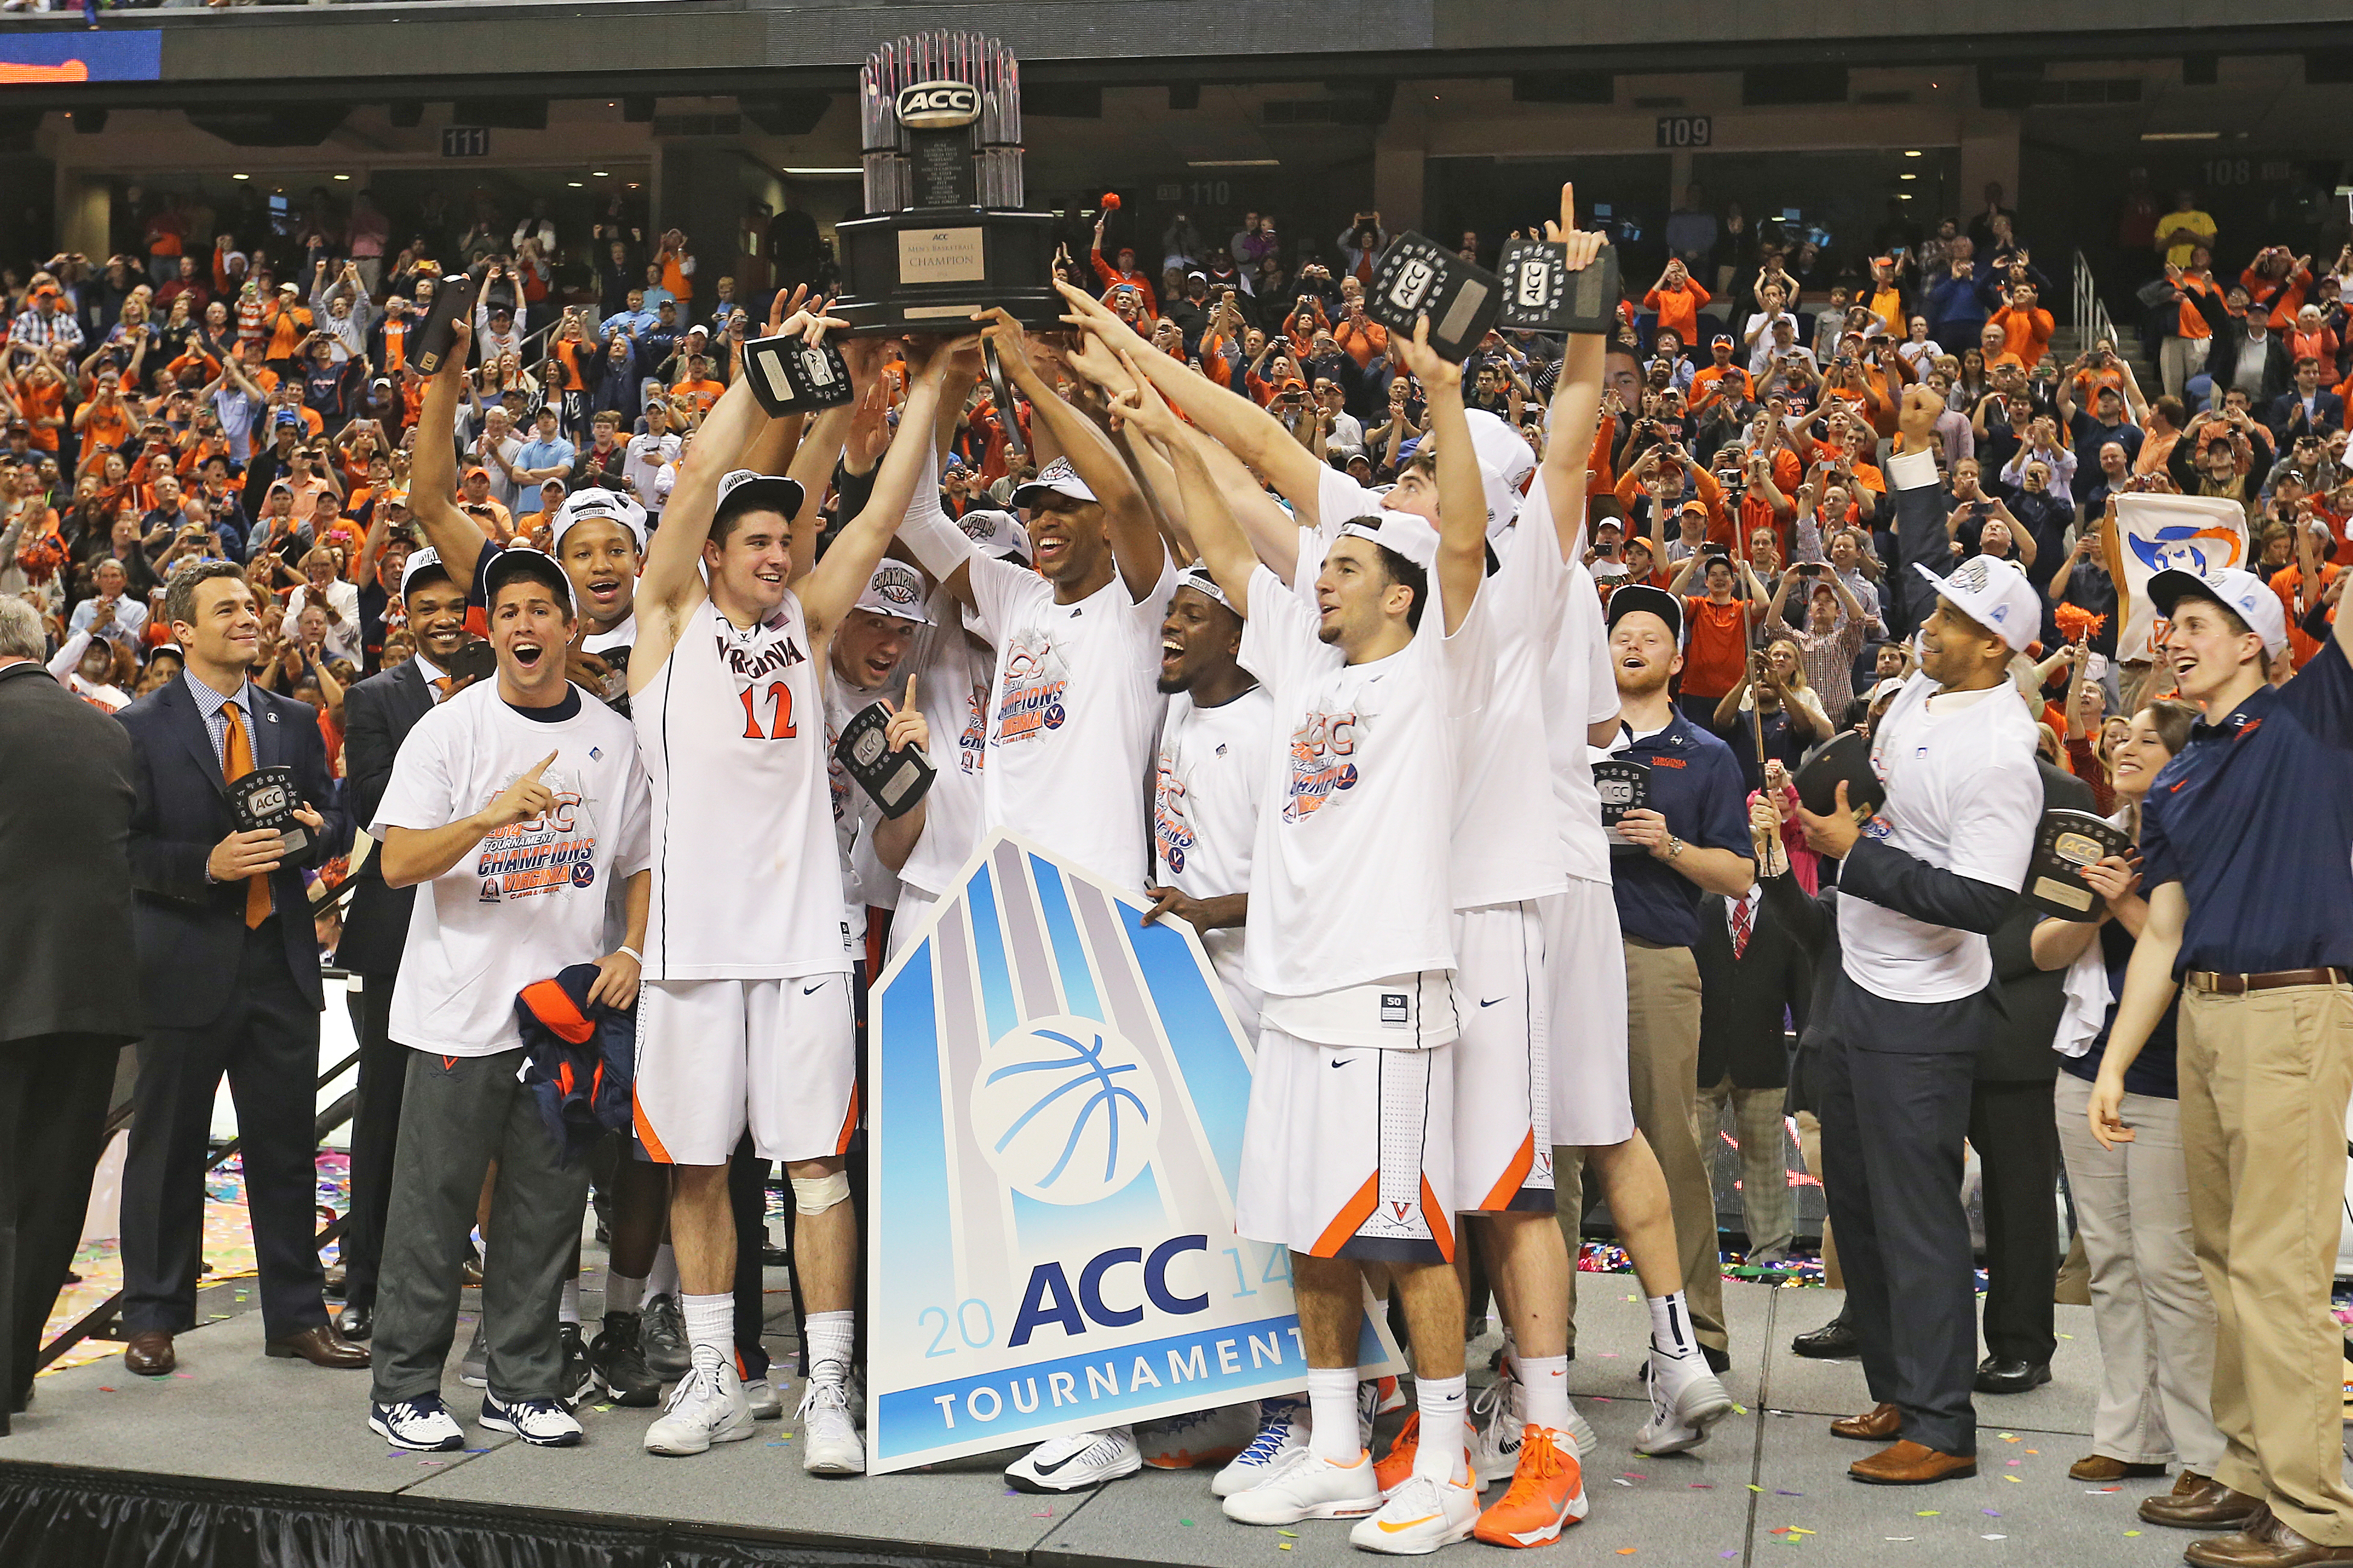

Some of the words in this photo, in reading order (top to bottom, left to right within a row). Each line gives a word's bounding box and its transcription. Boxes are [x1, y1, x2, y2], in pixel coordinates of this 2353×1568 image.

[903, 90, 973, 113] ACC
[447, 129, 485, 155] 111
[1660, 119, 1708, 145] 109
[2203, 159, 2249, 185] 108
[1190, 181, 1229, 205] 110
[910, 255, 973, 266] CHAMPION
[1399, 265, 1426, 305] ACC
[1526, 265, 1541, 301] ACC
[808, 352, 830, 382] ACC
[716, 636, 806, 679] VRGINIA
[739, 681, 797, 740] 12
[860, 733, 881, 762] ACC
[254, 791, 281, 811] ACC
[484, 832, 556, 852] TOURNAMENT
[2063, 840, 2100, 859] ACC
[478, 838, 596, 877] CHAMPIONS
[503, 865, 571, 893] VIRGINIA
[510, 886, 560, 900] CAVALIERS
[1387, 997, 1402, 1006] 50
[918, 1299, 995, 1359] 20
[1222, 1243, 1295, 1299] 14
[1007, 1234, 1209, 1349] ACC
[933, 1326, 1308, 1429] TOURNAMENT
